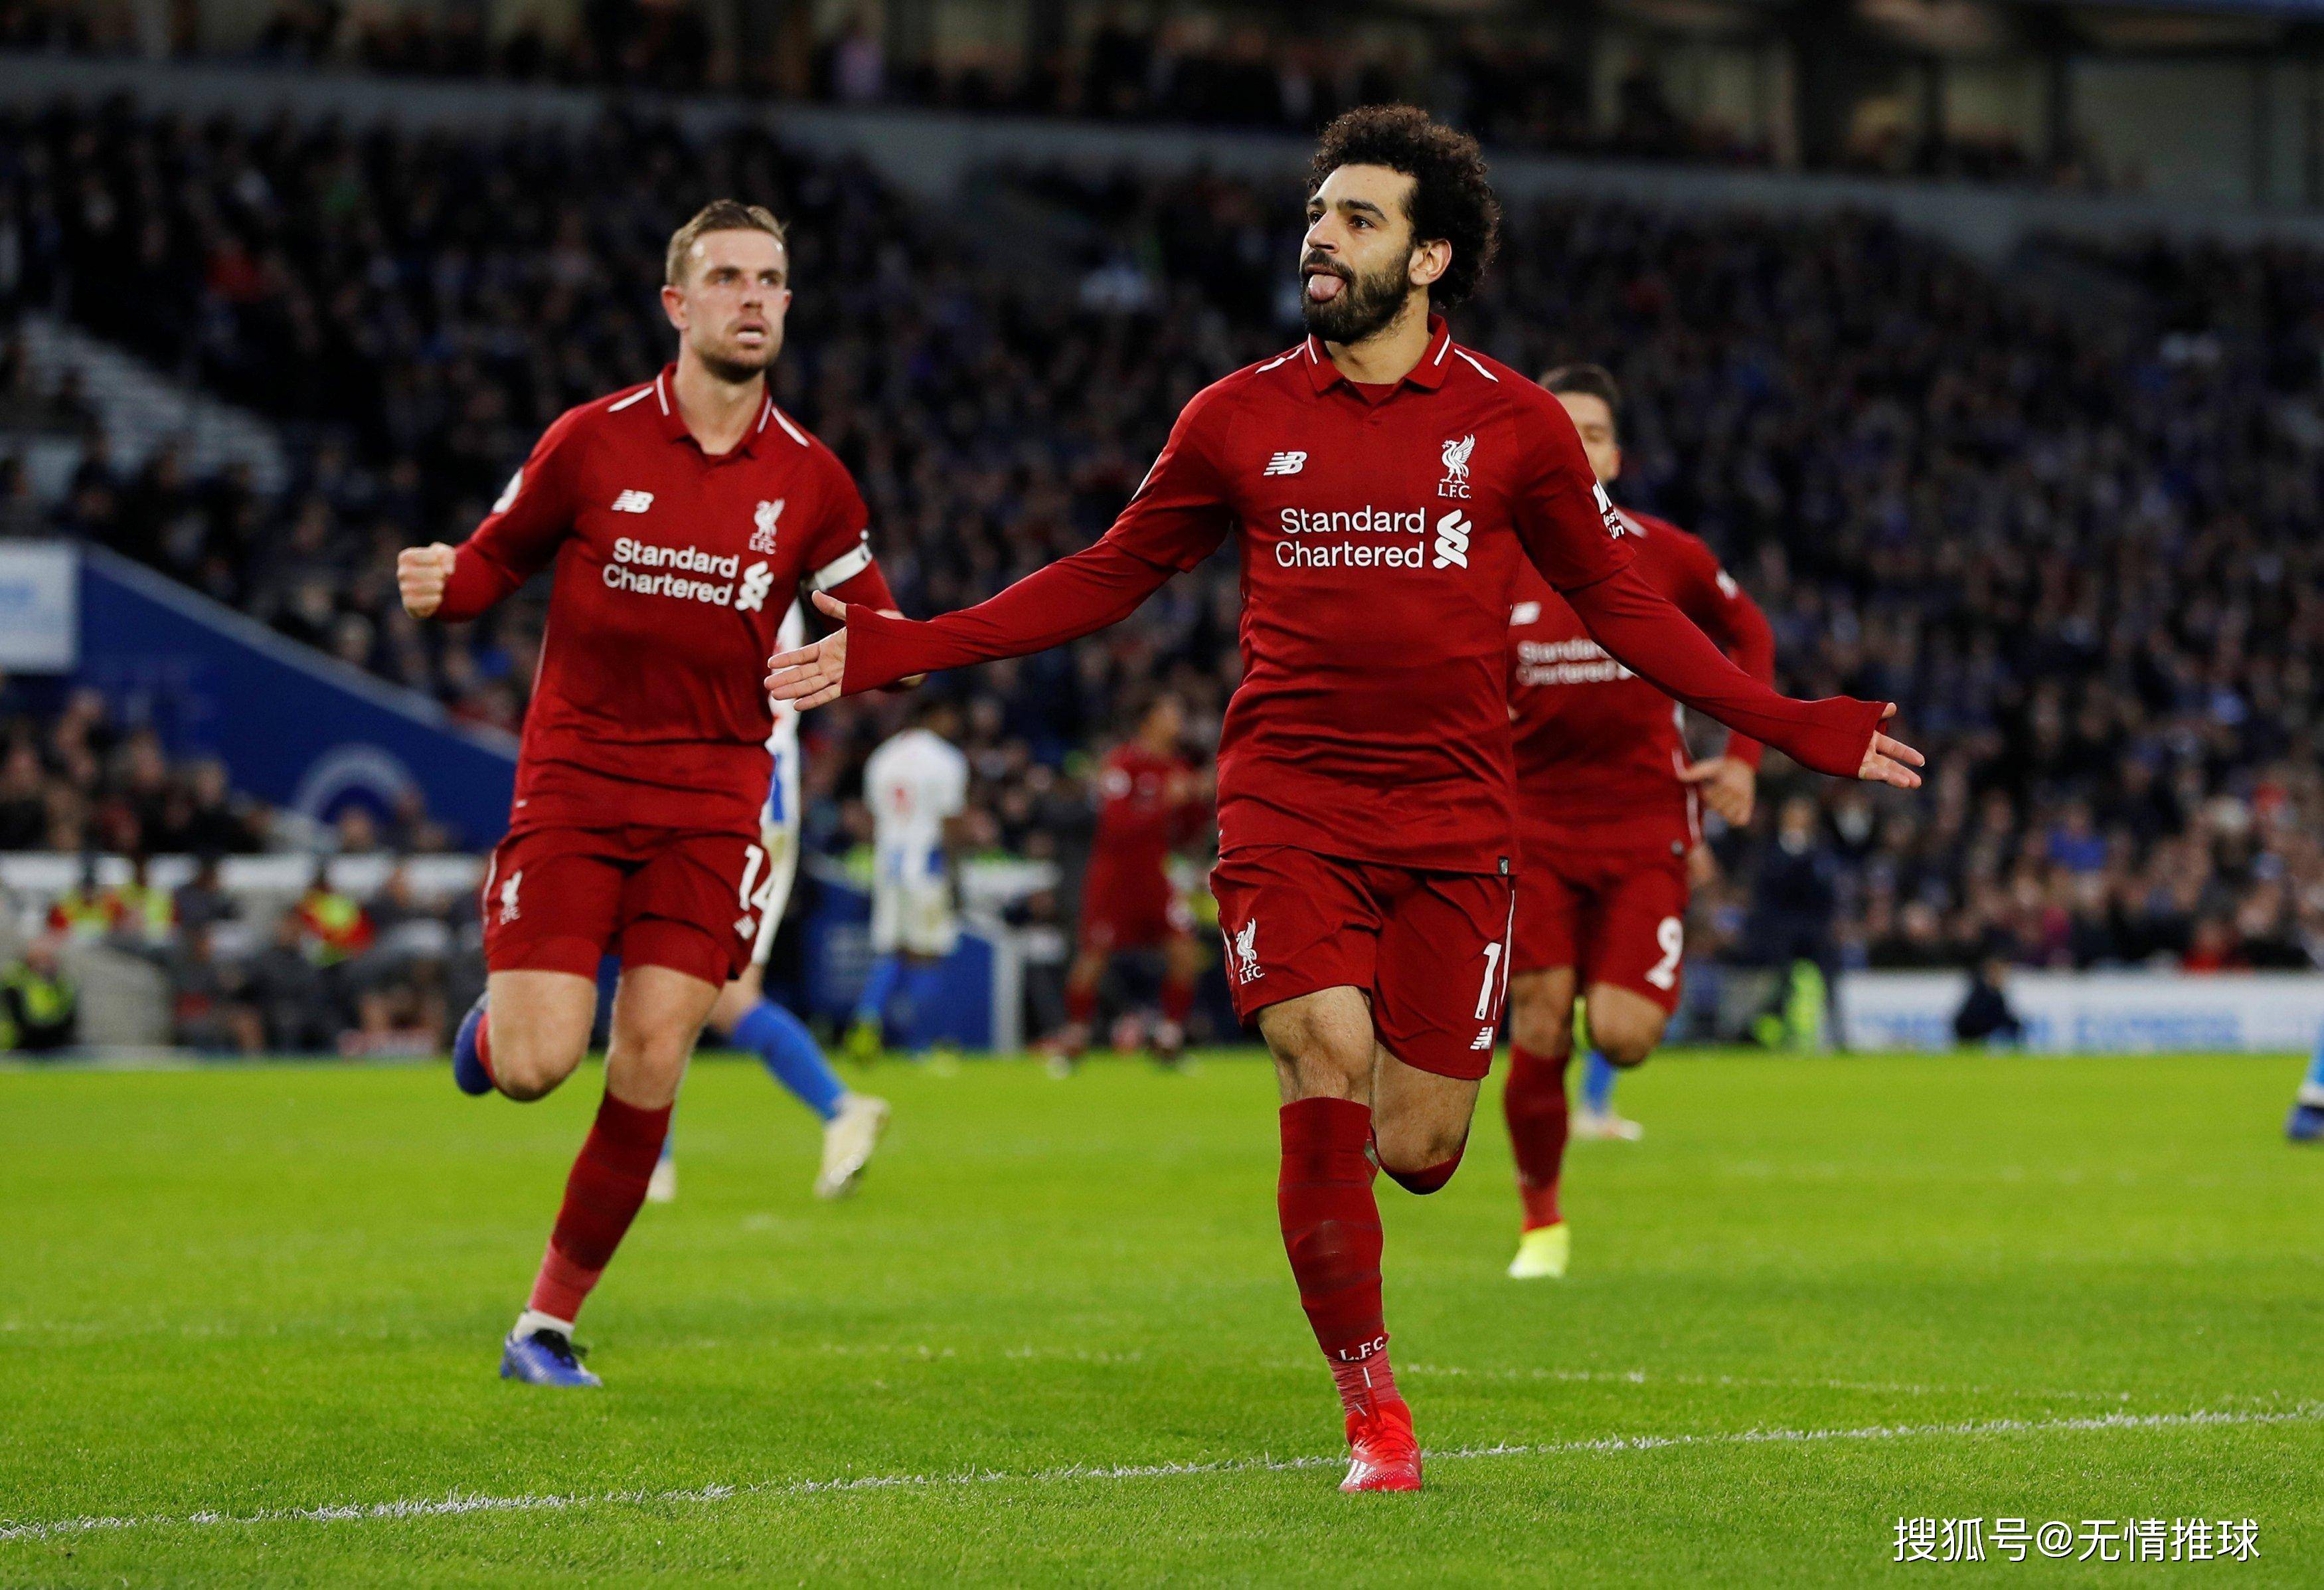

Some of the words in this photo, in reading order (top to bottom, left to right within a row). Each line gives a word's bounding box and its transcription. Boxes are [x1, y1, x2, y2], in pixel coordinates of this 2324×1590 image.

[1281, 505, 1425, 534] Standard
[613, 537, 740, 579] Standard
[1276, 541, 1424, 568] Chartered
[602, 563, 734, 606] Chartered
[1644, 917, 1684, 990] 9
